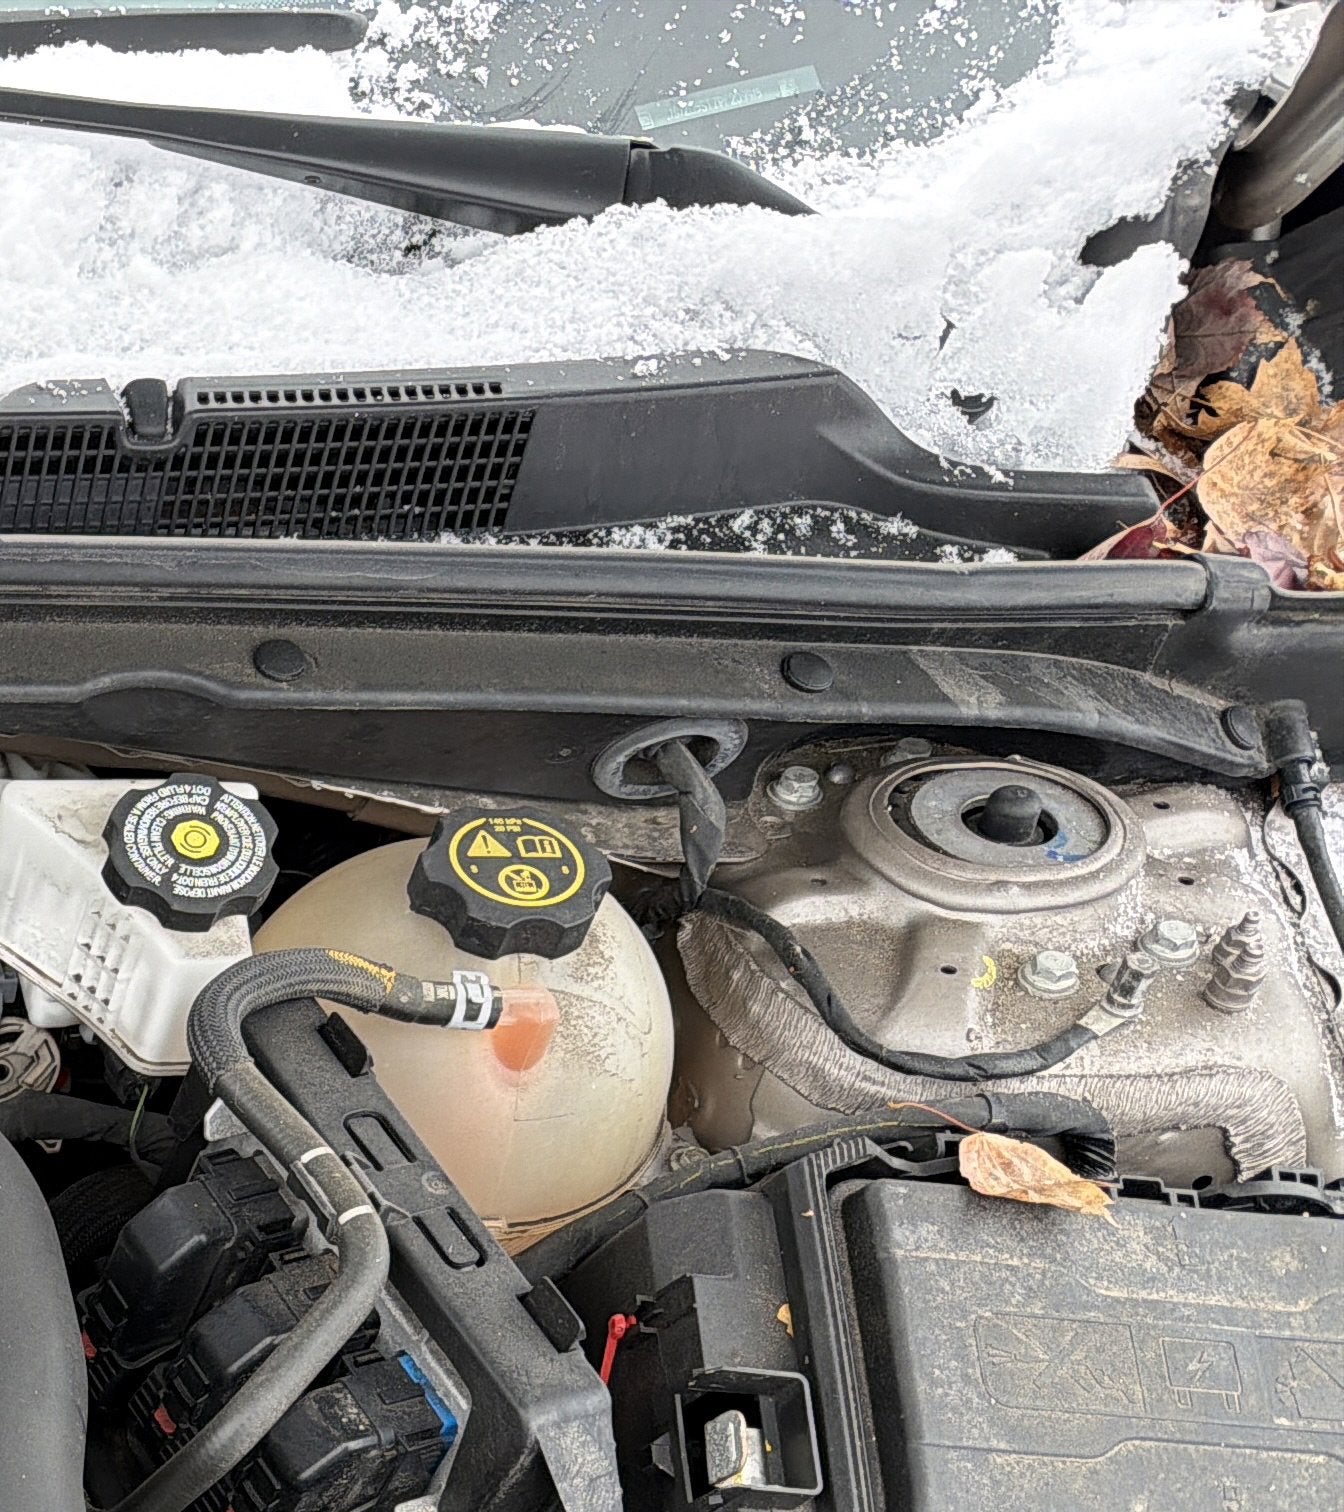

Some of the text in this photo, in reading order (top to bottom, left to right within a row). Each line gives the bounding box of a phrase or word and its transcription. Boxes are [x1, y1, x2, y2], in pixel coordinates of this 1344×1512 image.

[157, 785, 185, 799] FLUID
[192, 784, 212, 796] DOT
[137, 792, 161, 812] FROM
[153, 794, 188, 812] BEFORE
[187, 794, 210, 806] CAP
[124, 813, 140, 843] SEALED
[150, 816, 168, 841] CLEAN
[137, 843, 153, 858] USE
[150, 842, 175, 868] FILLER
[144, 855, 169, 877] ONLY
[176, 875, 193, 887] DOT
[194, 877, 220, 888] FREIN
[229, 864, 261, 891] BOUCHON
[206, 883, 234, 898] AVANT
